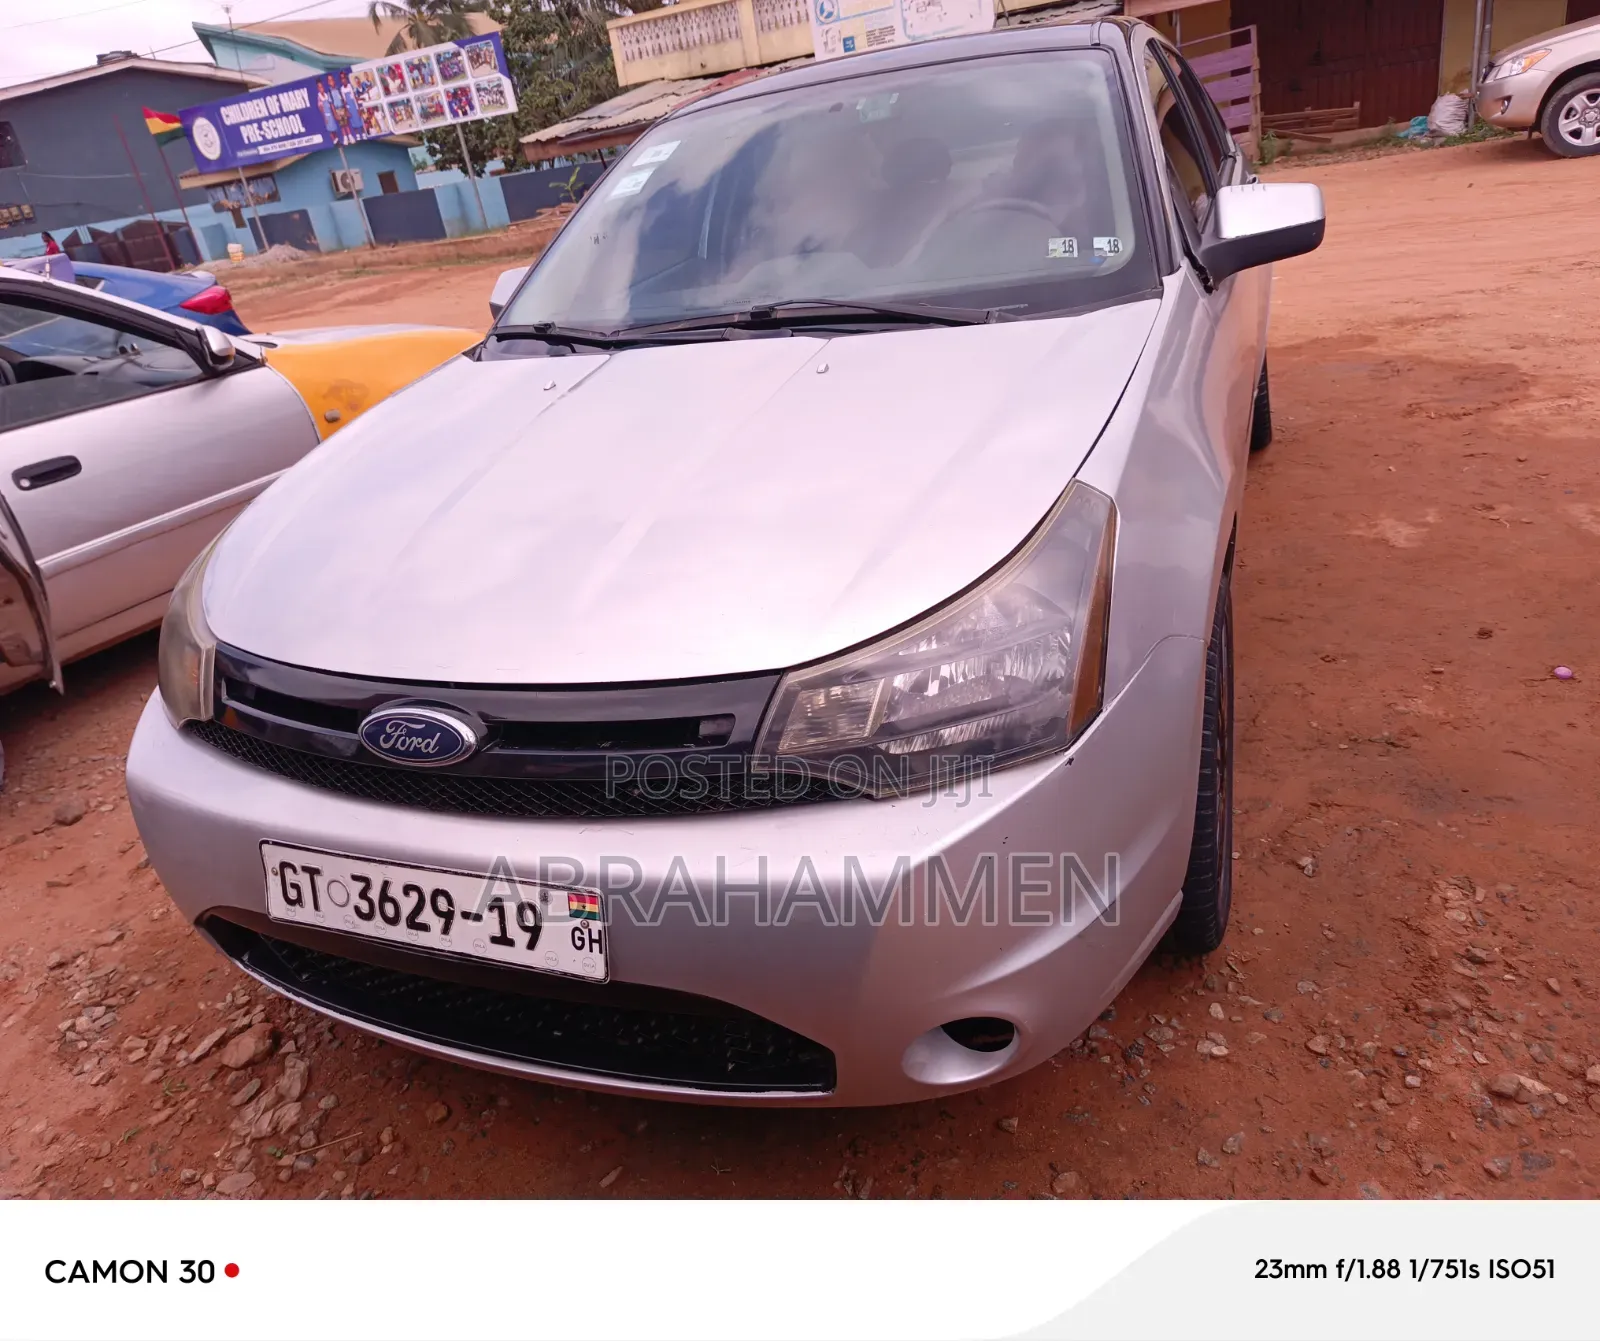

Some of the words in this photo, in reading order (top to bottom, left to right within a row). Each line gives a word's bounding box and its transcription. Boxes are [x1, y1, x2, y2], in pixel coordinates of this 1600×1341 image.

[220, 97, 269, 126] CHILDREN
[265, 94, 281, 116] OF
[278, 87, 311, 113] MARY
[240, 113, 306, 145] PRE-SCHOOL
[1062, 239, 1075, 254] 18
[1107, 239, 1120, 254] 18
[380, 719, 441, 754] Ford
[279, 860, 323, 912] GT
[350, 873, 543, 951] 3629-19
[571, 926, 603, 954] GH
